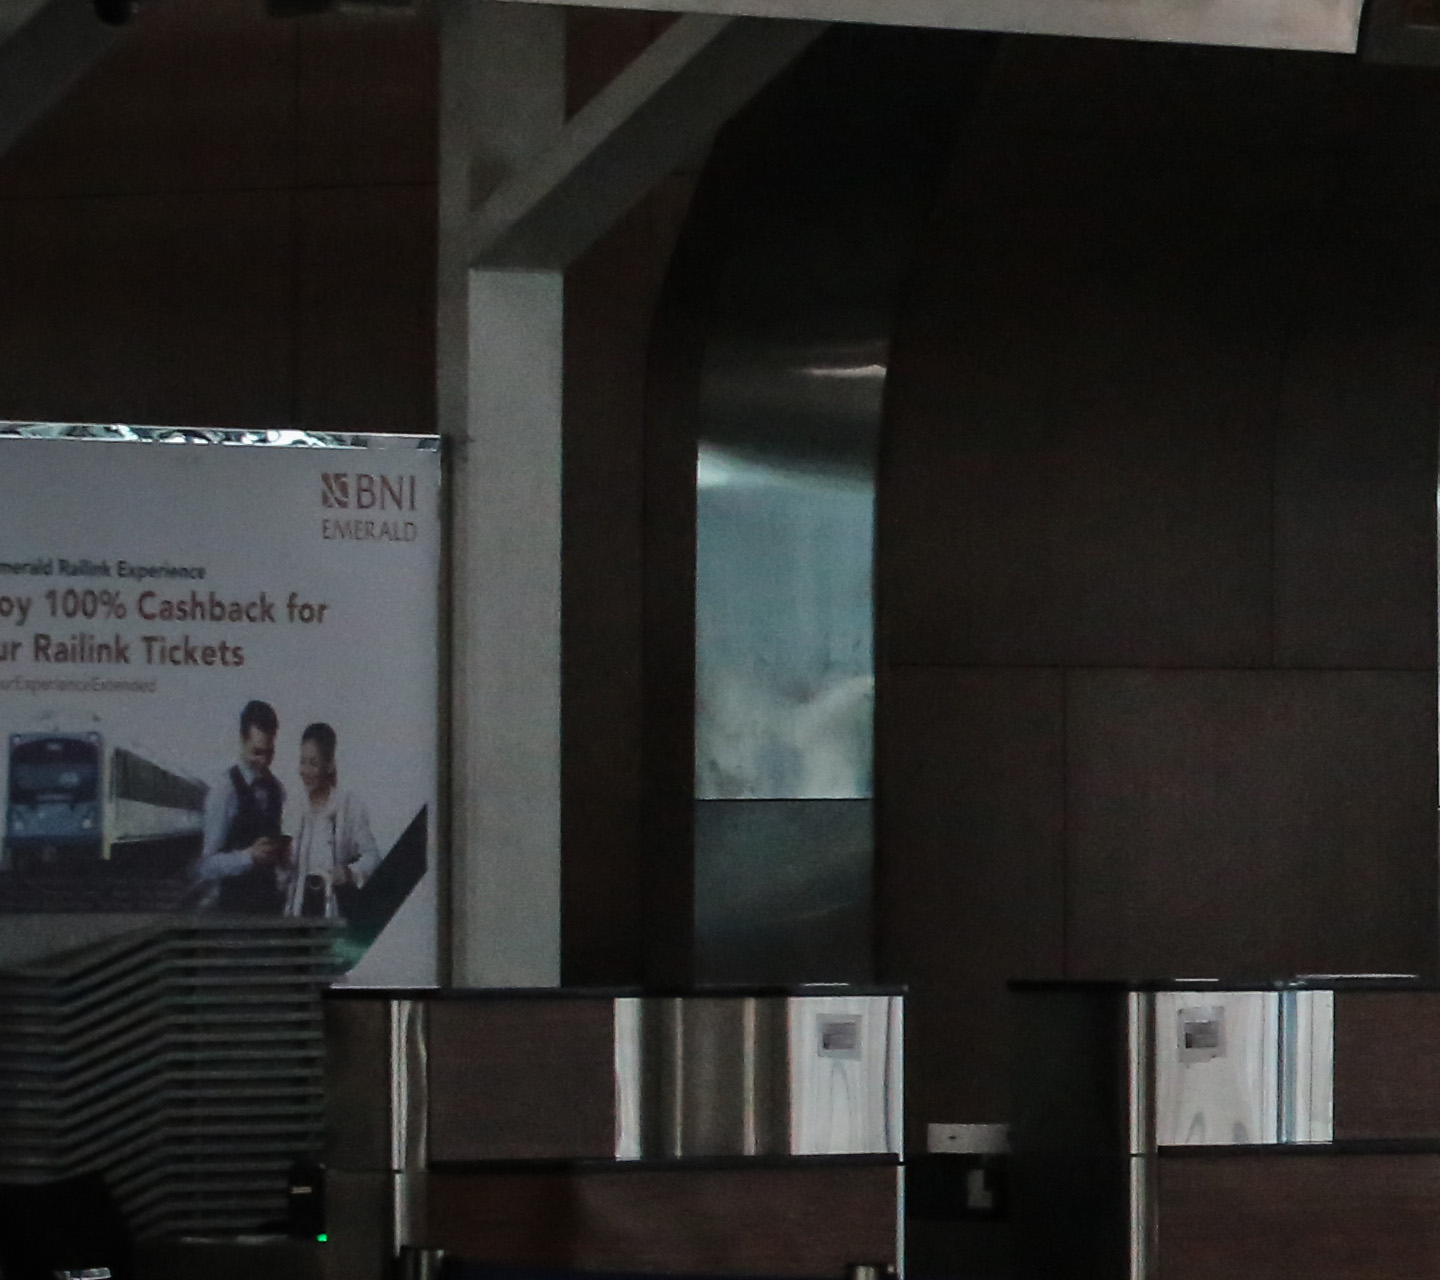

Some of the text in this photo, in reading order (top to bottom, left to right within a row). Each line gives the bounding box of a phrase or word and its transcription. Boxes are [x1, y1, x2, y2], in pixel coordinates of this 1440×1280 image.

[356, 474, 417, 511] BNI
[322, 519, 418, 542] EMERALD
[58, 559, 110, 577] Railink
[117, 561, 206, 580] Experience
[45, 590, 126, 619] 100%
[138, 591, 275, 623] Cashback
[287, 593, 328, 624] for
[34, 633, 130, 664] Railink
[140, 636, 245, 666] Tickets
